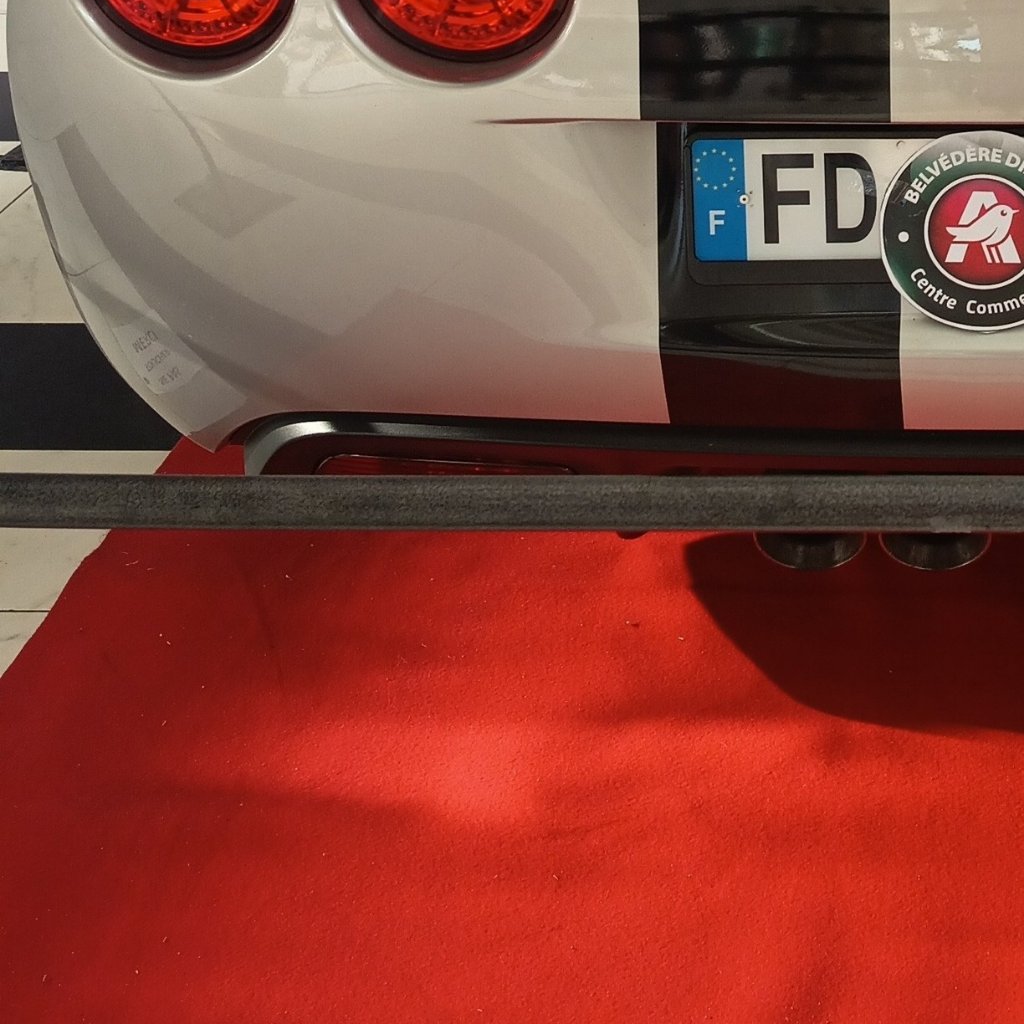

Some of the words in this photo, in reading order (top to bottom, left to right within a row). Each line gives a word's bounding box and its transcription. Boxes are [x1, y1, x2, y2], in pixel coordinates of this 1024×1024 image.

[903, 145, 1003, 205] BELVÉDÈRE
[708, 209, 726, 236] F
[910, 267, 958, 310] Centre
